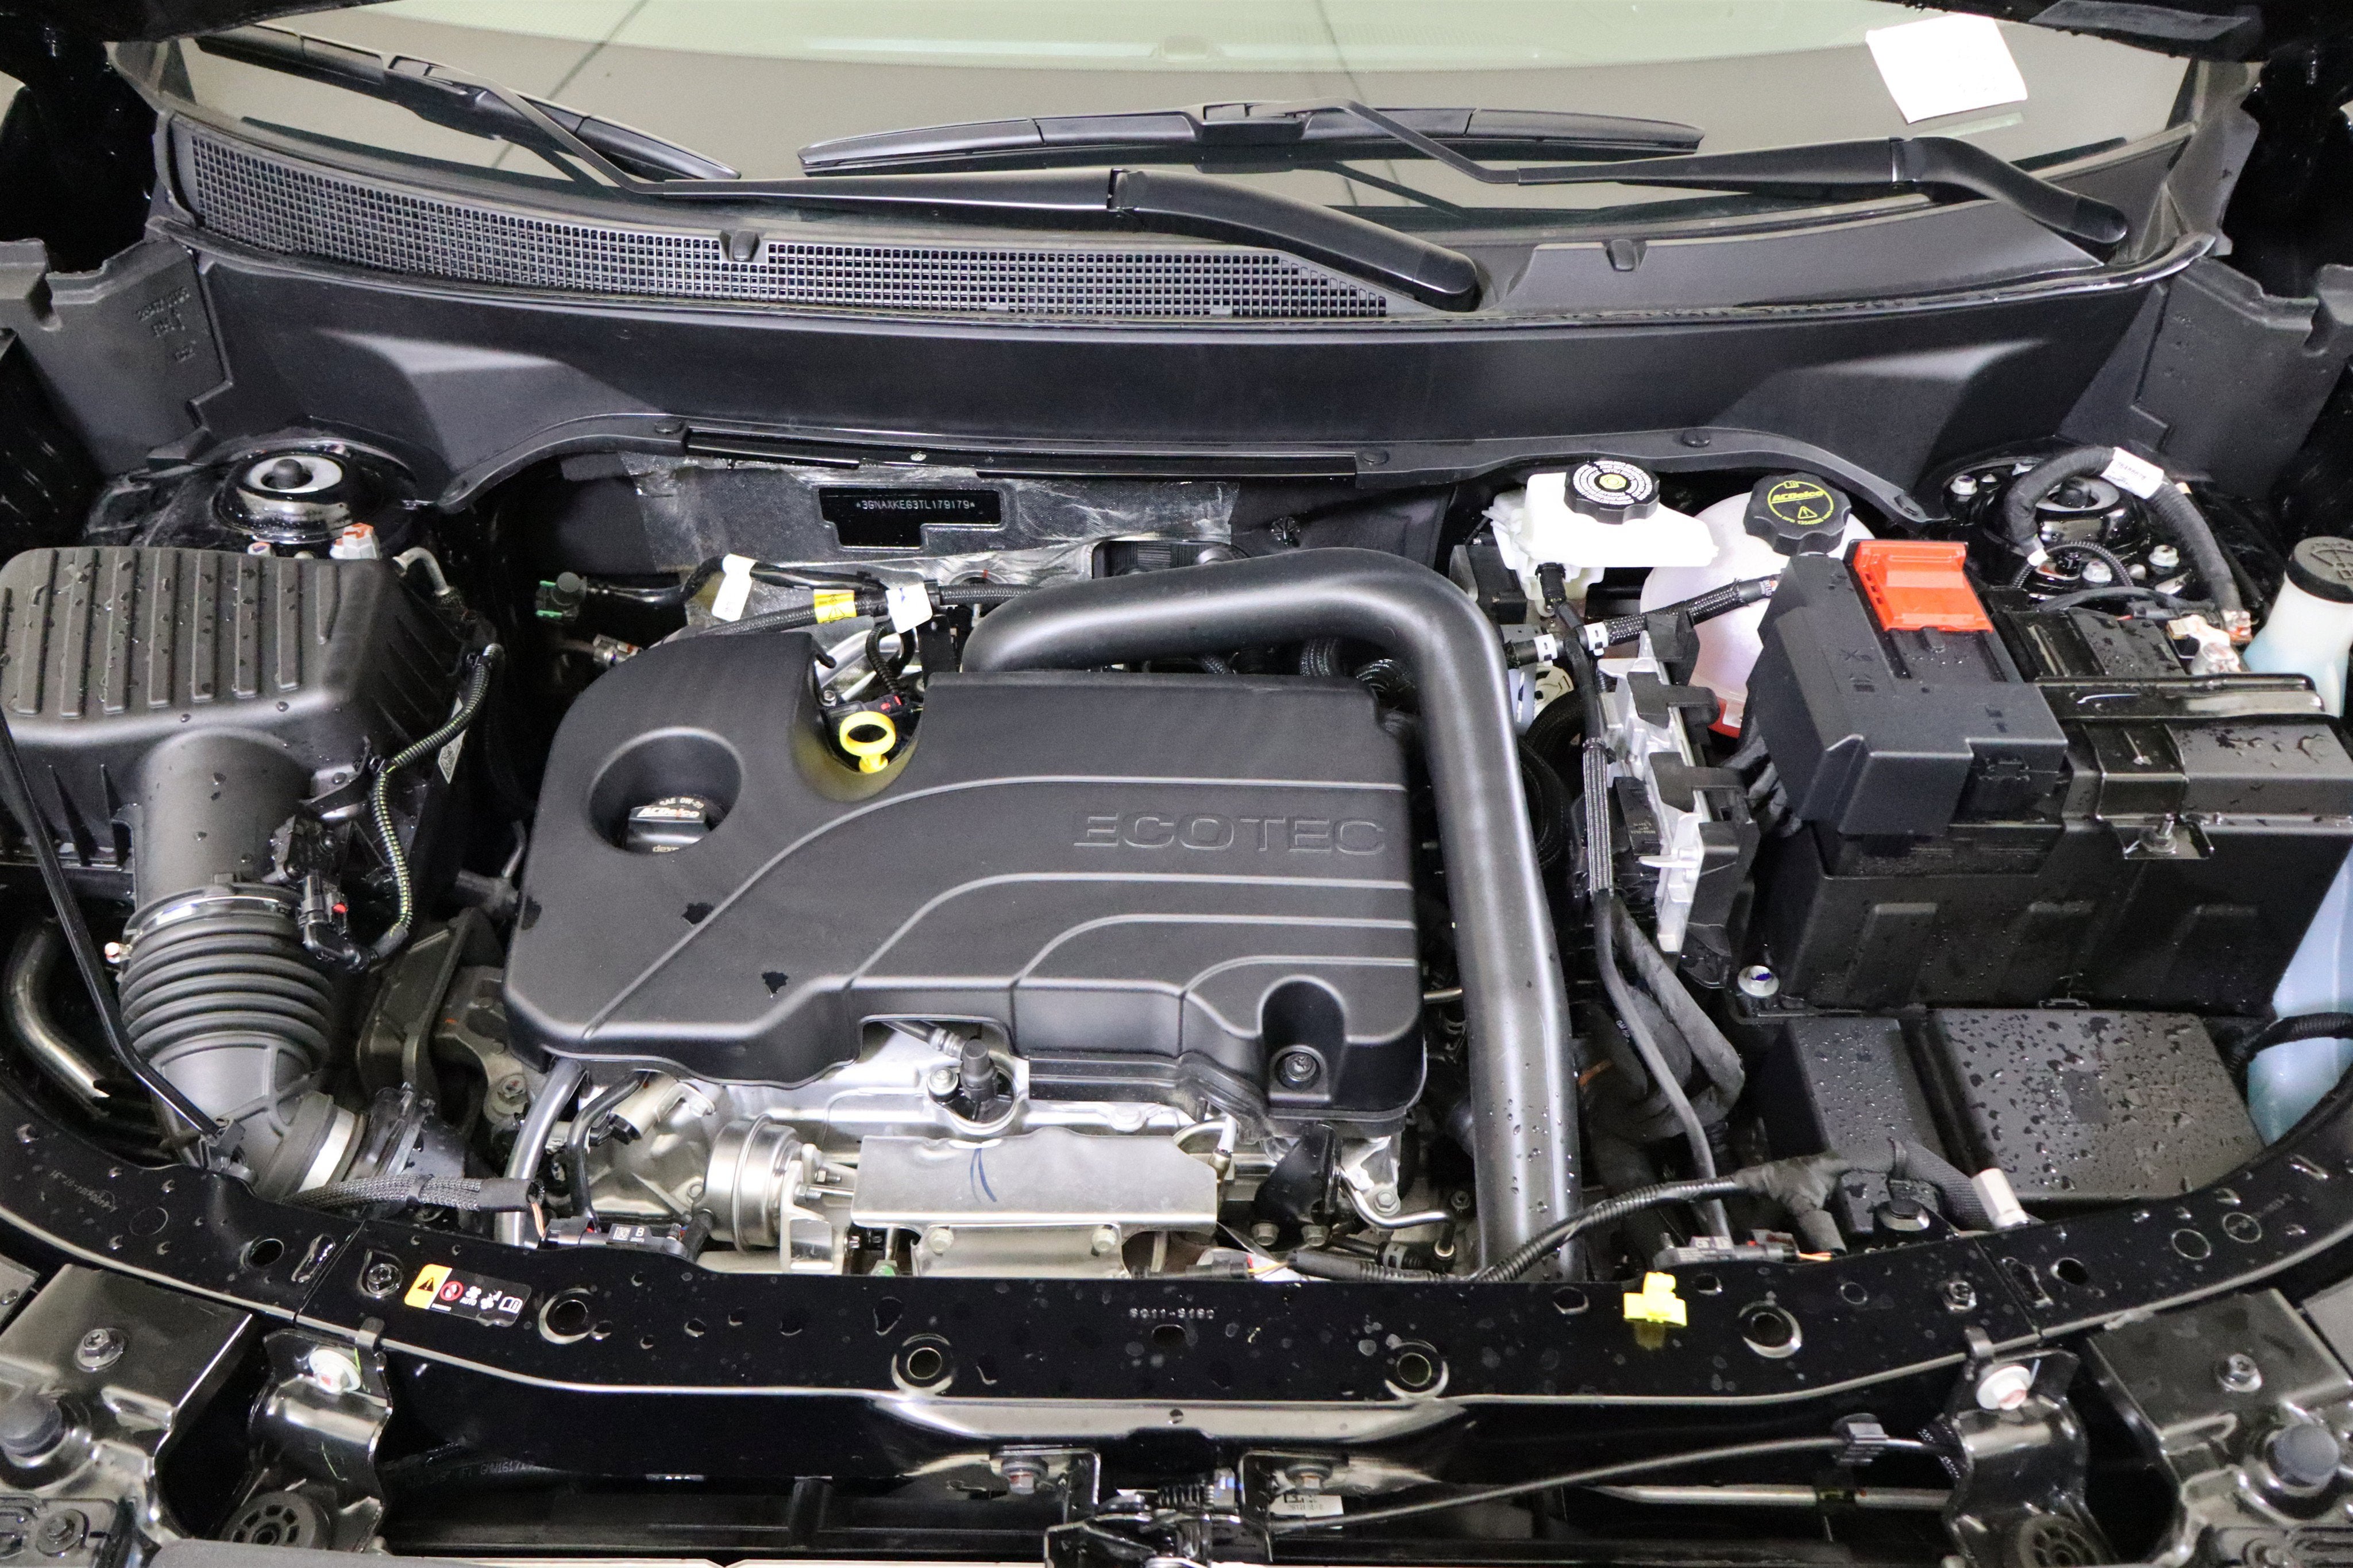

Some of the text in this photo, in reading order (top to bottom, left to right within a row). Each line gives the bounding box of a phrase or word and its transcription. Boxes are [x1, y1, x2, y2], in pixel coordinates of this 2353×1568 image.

[1772, 491, 1824, 501] ACDelco
[679, 797, 704, 809] 0W-20
[637, 807, 700, 818] ACDelco
[1073, 811, 1386, 856] ECOTEC
[460, 1297, 477, 1307] AUTO
